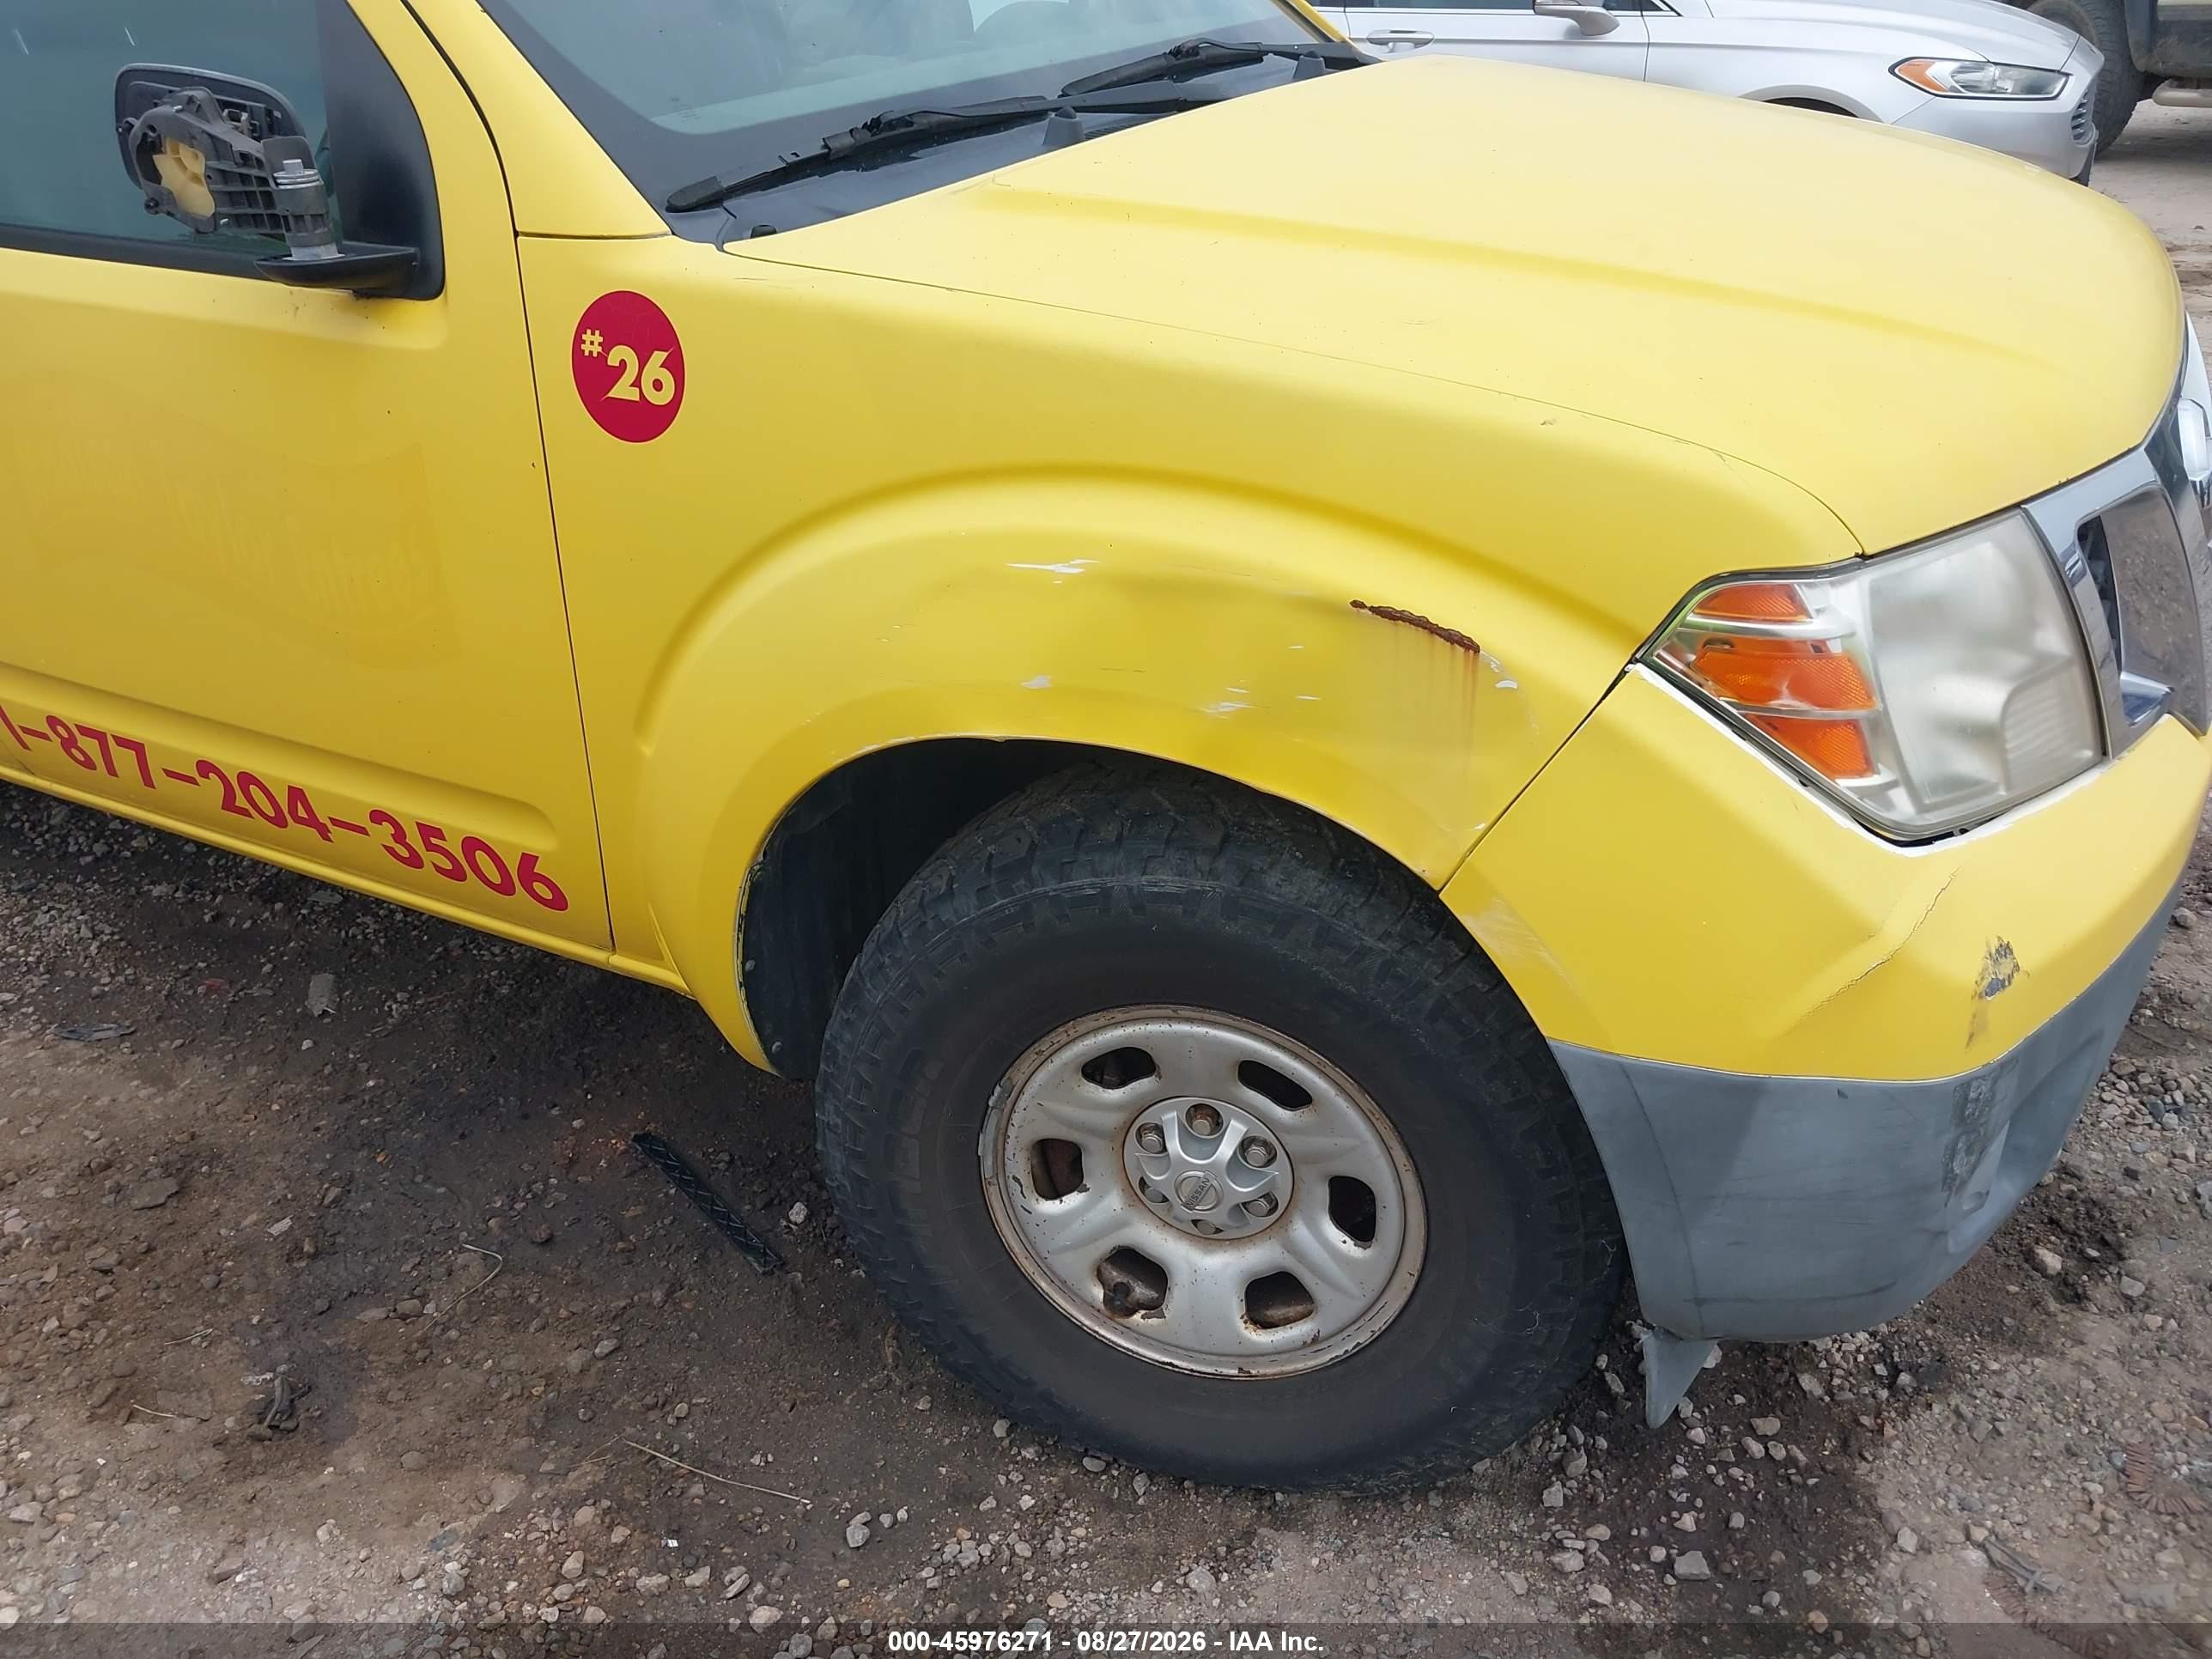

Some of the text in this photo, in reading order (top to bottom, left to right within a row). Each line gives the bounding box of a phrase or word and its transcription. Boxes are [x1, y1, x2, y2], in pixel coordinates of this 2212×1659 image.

[580, 328, 676, 406] #26
[0, 705, 569, 912] 1-877-204-3506
[1187, 1177, 1210, 1209] NISSAN
